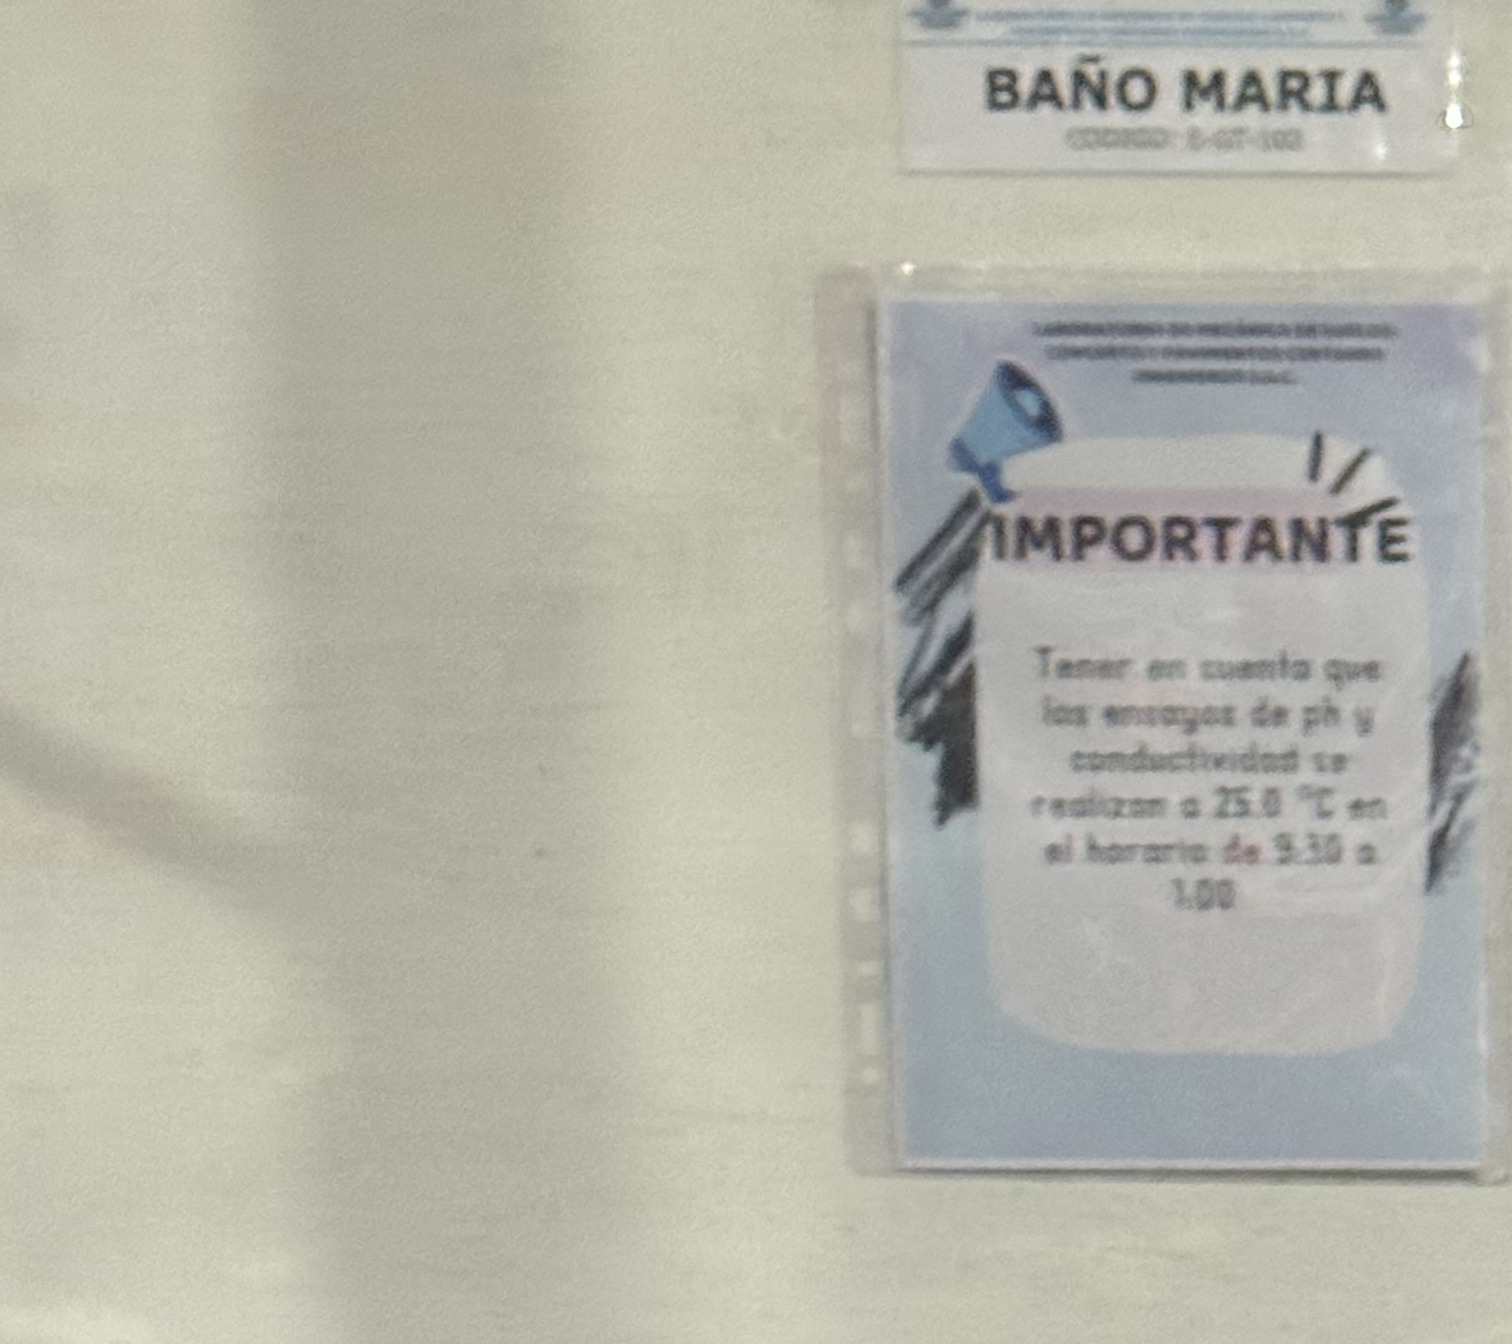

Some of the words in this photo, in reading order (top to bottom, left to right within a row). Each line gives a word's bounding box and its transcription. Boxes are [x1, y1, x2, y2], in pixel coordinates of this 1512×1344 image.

[985, 53, 1158, 113] BAÑO
[1181, 67, 1388, 113] MARIA
[991, 513, 1412, 563] IMPORTANTE
[1036, 645, 1130, 680] Tener
[1146, 657, 1187, 681] en
[1200, 649, 1311, 681] cuenta
[1323, 658, 1381, 690] que
[1043, 696, 1087, 727] los
[1250, 696, 1290, 728] de
[1069, 741, 1298, 774] conductividad
[1347, 797, 1387, 820] en
[1084, 832, 1207, 864] horario
[1222, 832, 1263, 864] de
